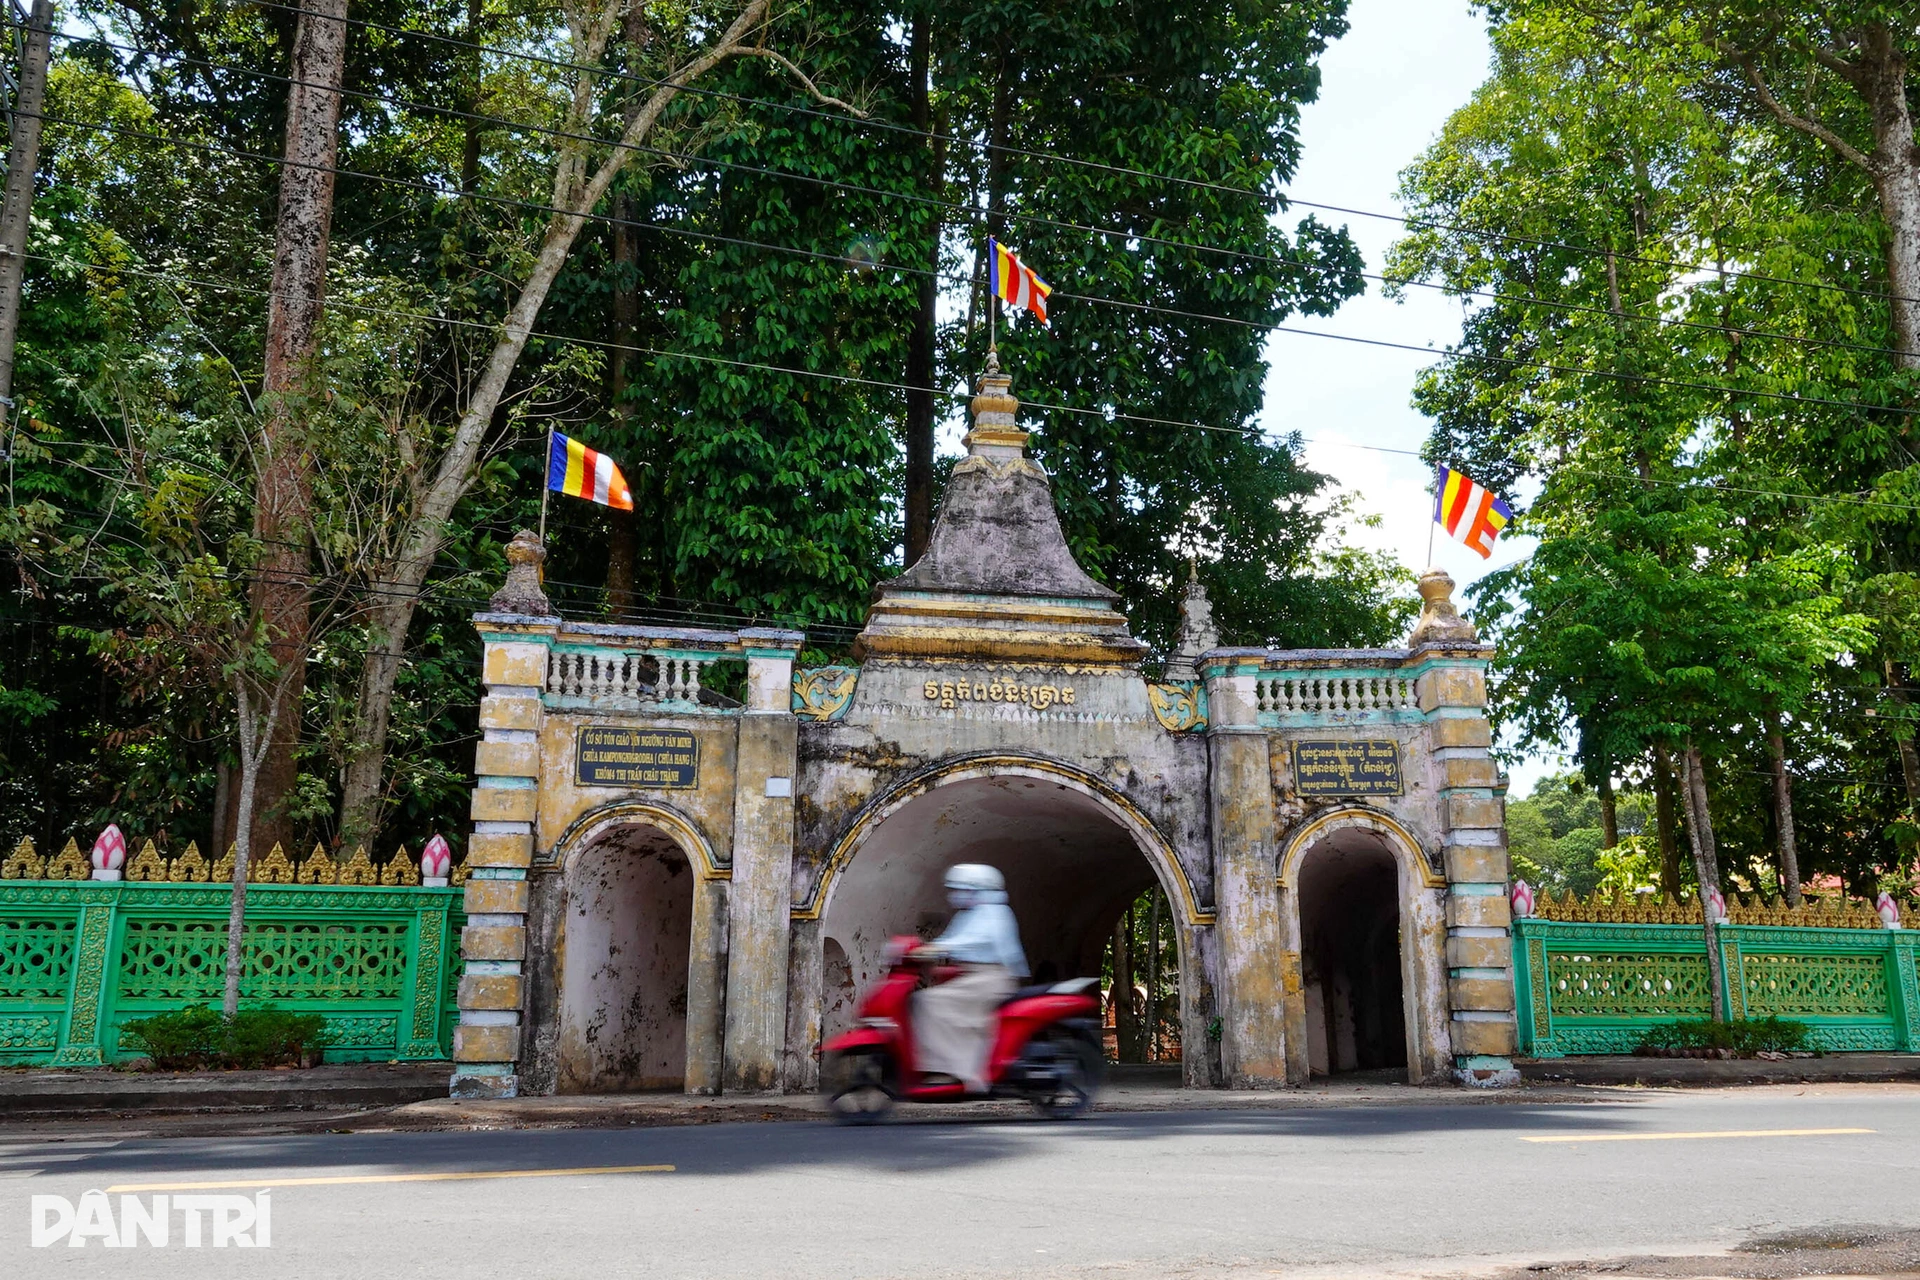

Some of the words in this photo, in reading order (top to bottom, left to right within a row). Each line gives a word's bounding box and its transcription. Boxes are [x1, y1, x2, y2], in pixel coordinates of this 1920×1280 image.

[594, 731, 603, 745] SỞ
[603, 731, 615, 745] TÔN
[615, 732, 630, 746] GIÁO
[676, 737, 692, 748] MINH
[582, 748, 598, 762] CHÙA
[658, 751, 673, 765] CHÙA
[674, 754, 690, 765] HANG
[616, 769, 626, 783] THỊ
[627, 765, 643, 781] TRẤN
[643, 767, 659, 781] CHÂU
[660, 768, 679, 782] THÀNH
